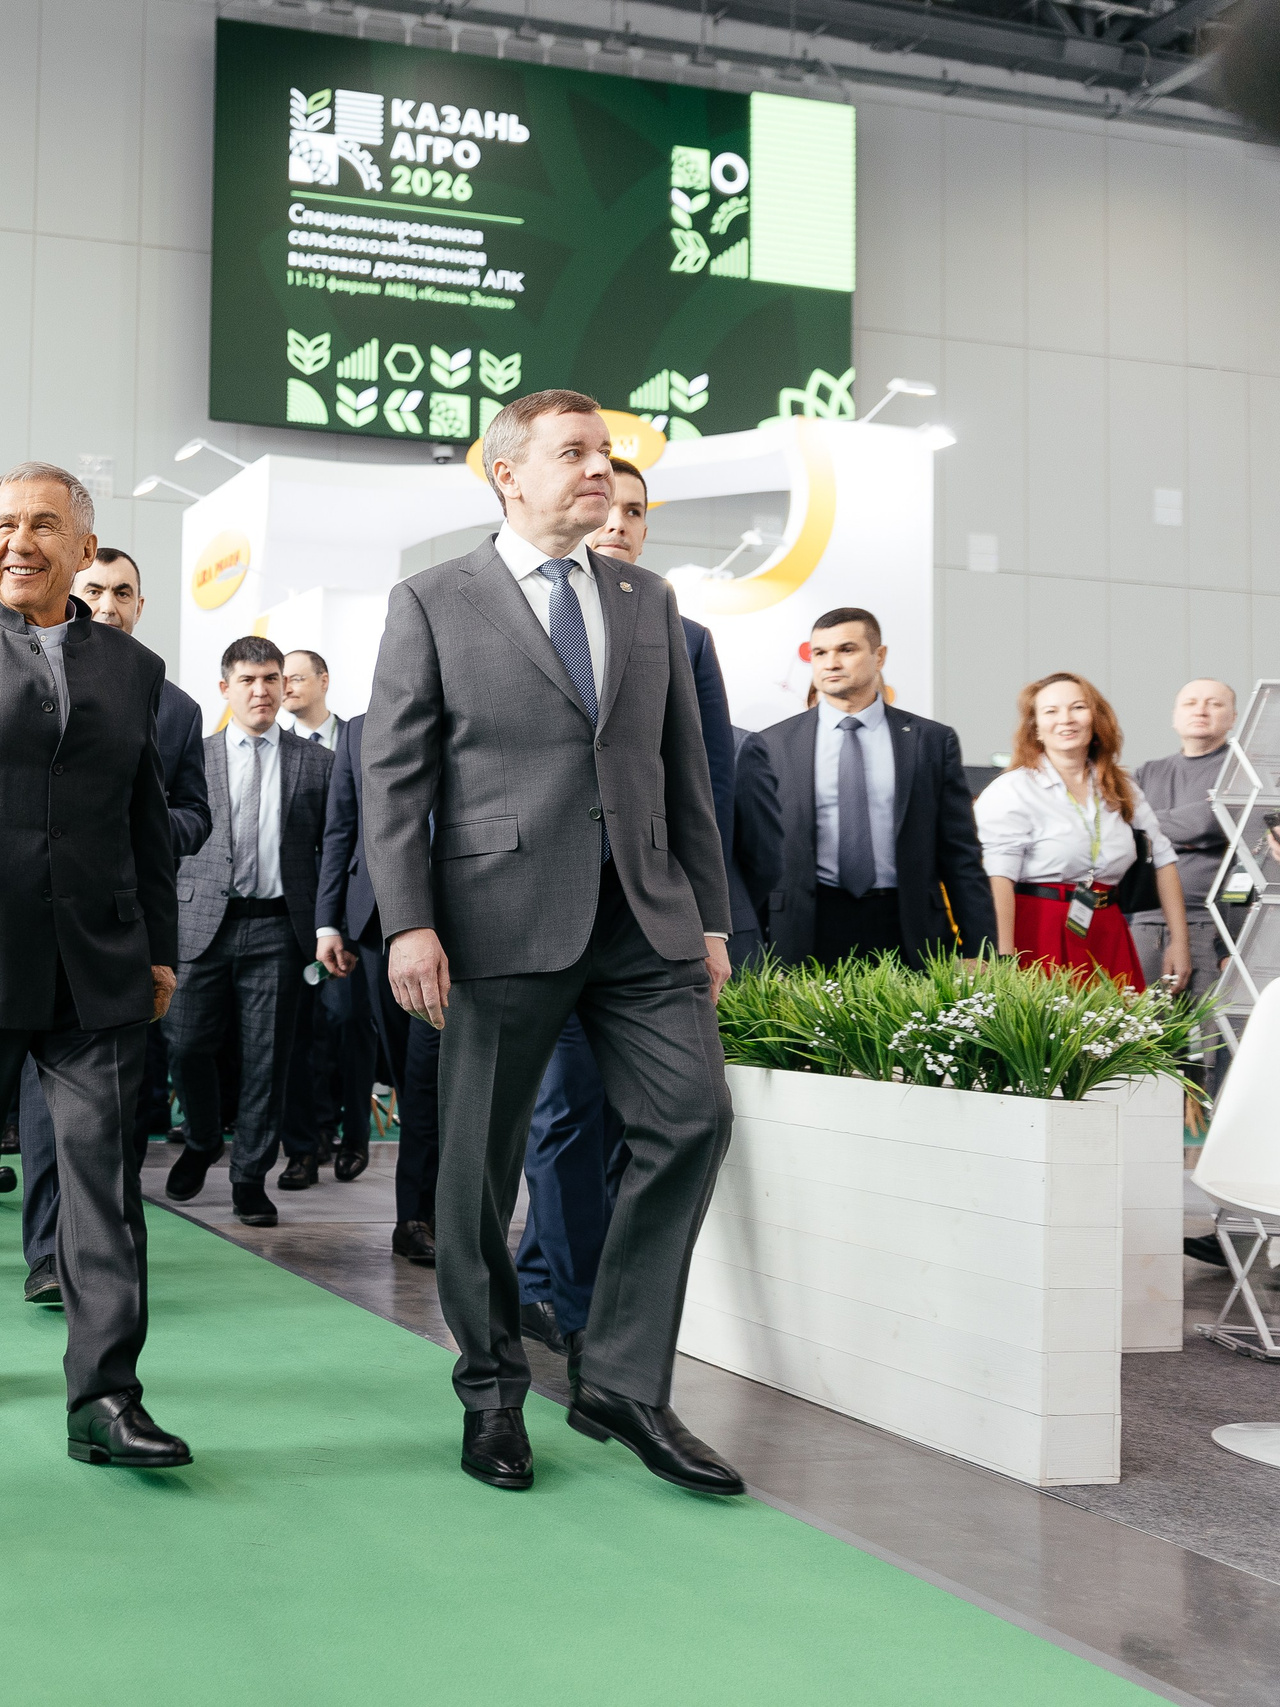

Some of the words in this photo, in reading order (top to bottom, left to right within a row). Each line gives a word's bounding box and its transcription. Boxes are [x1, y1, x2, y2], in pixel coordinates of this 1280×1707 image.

[391, 98, 530, 143] КАЗАНЬ
[390, 131, 481, 169] АГРО
[391, 164, 473, 202] 2026
[481, 268, 525, 292] АПК
